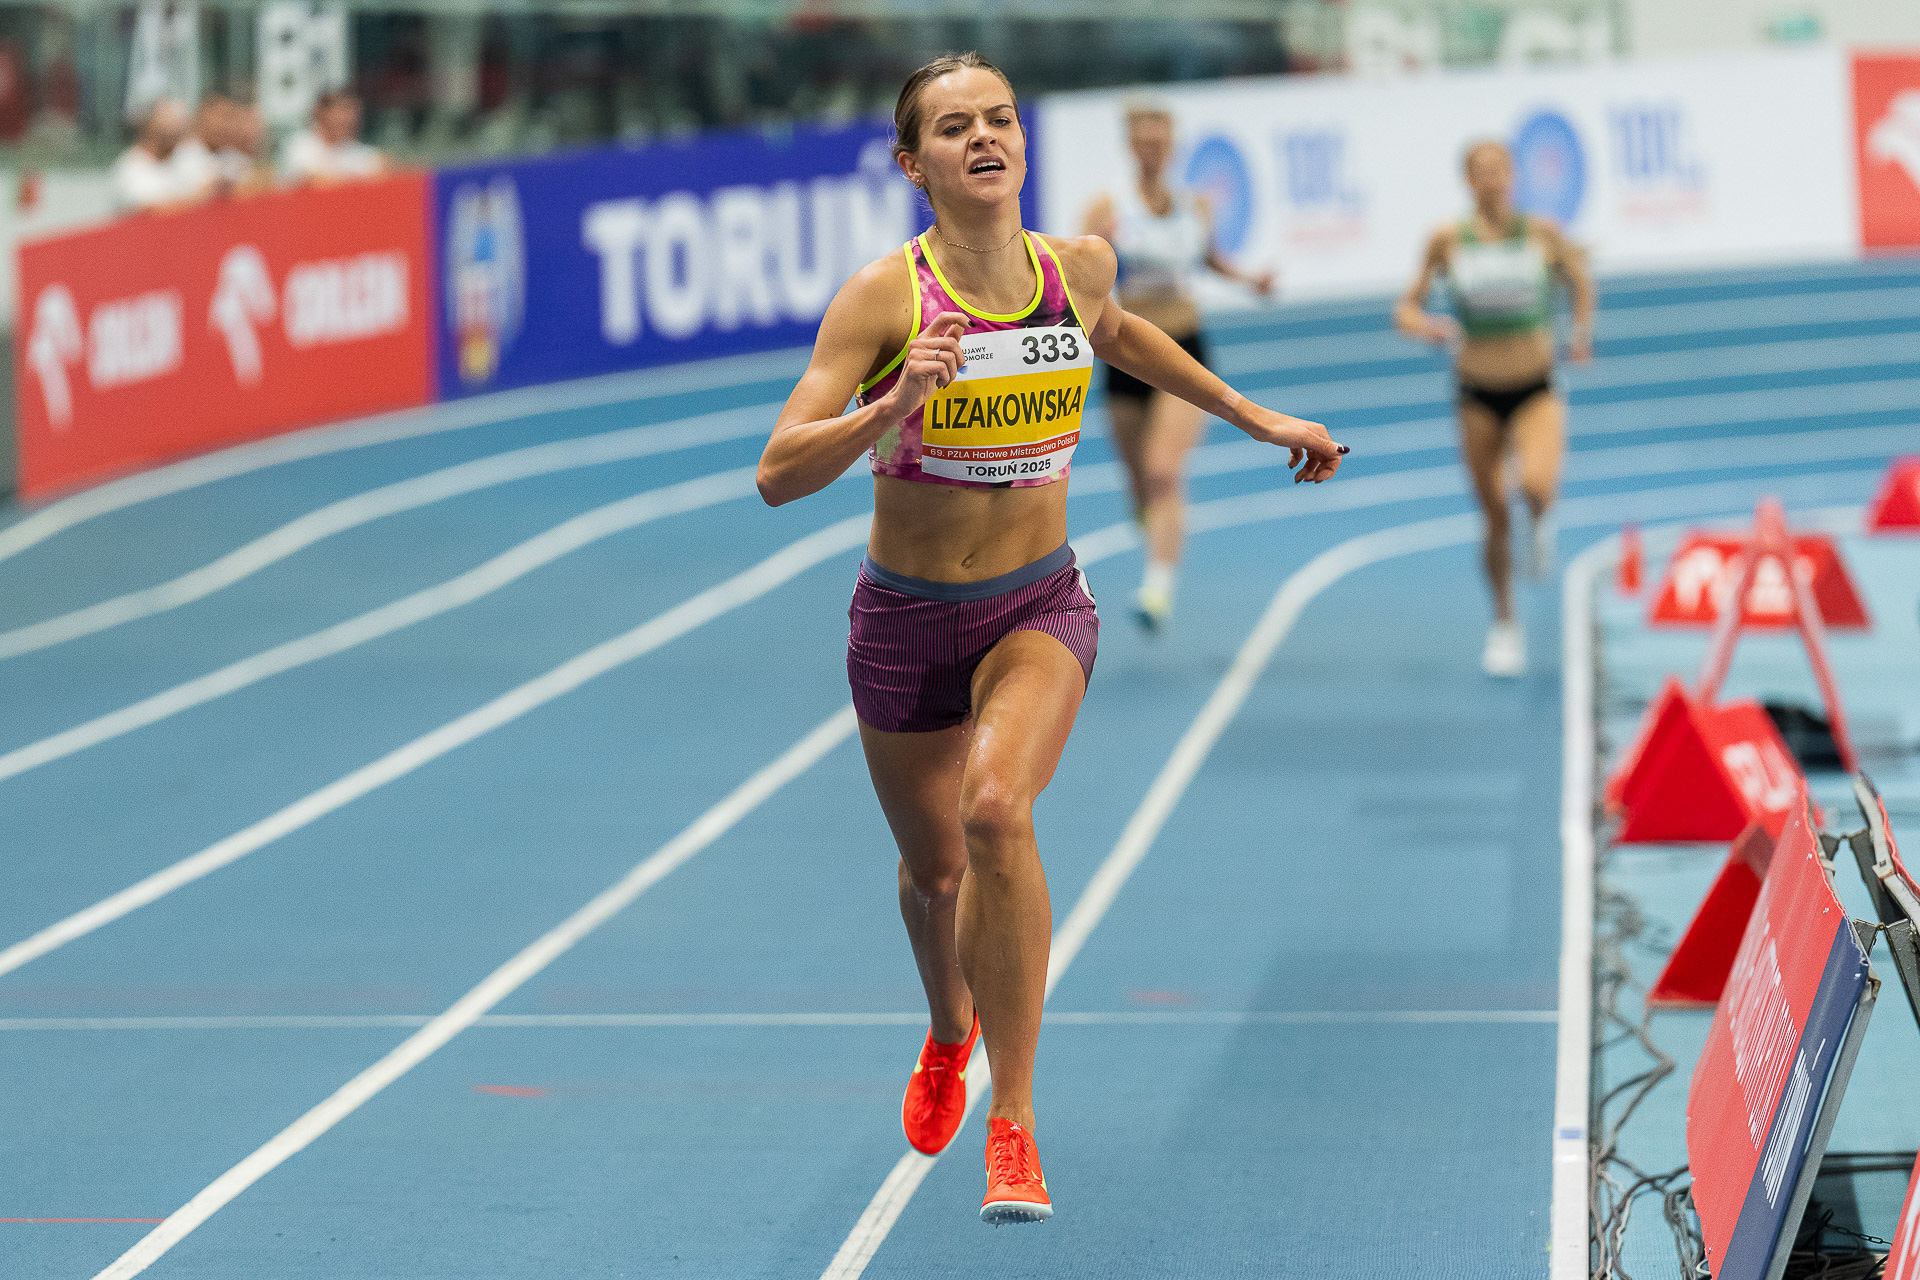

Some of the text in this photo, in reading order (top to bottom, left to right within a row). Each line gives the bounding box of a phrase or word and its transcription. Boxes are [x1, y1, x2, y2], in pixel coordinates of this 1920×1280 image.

[962, 346, 986, 355] UJAWY
[964, 352, 994, 362] OMORZE
[1021, 333, 1080, 365] 333
[932, 385, 1082, 430] LIZAKOWSKA
[930, 448, 945, 457] 69.
[972, 450, 1008, 459] Halowe
[1010, 442, 1056, 457] Mistrzostwa
[1057, 434, 1076, 448] Polski
[965, 458, 1051, 477] TORUŃ 2025
